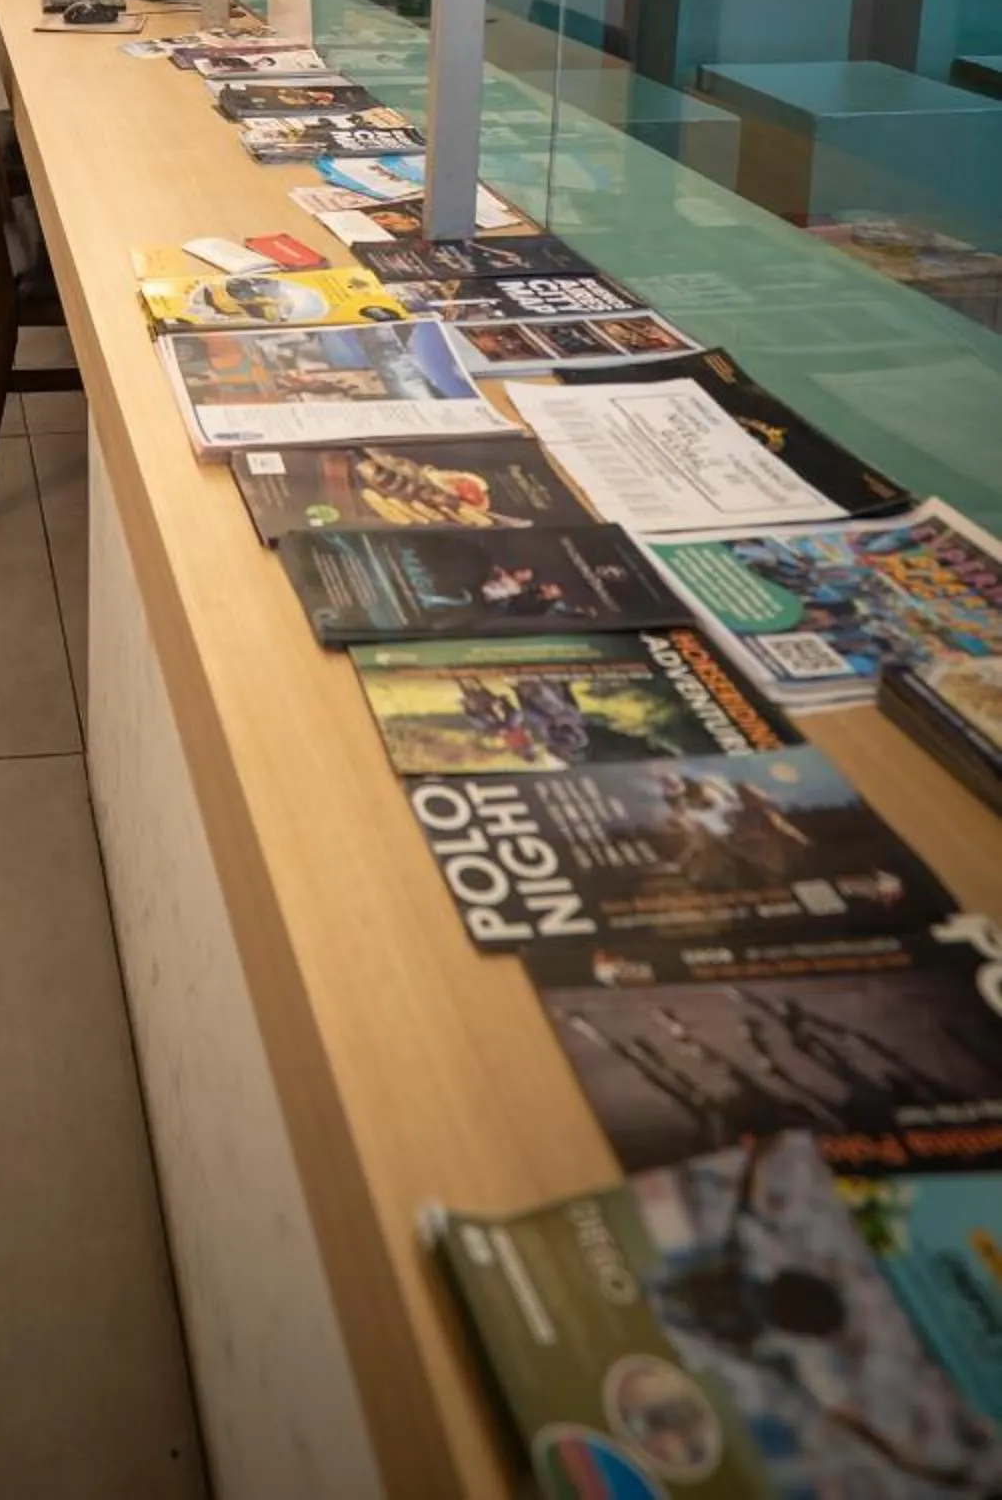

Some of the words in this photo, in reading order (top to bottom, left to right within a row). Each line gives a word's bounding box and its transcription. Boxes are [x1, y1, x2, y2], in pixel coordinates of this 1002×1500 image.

[496, 281, 557, 314] MAP
[527, 279, 592, 312] CITY
[639, 631, 754, 756] ADVENTUR
[411, 783, 534, 941] POLO
[464, 780, 597, 937] NIGHT
